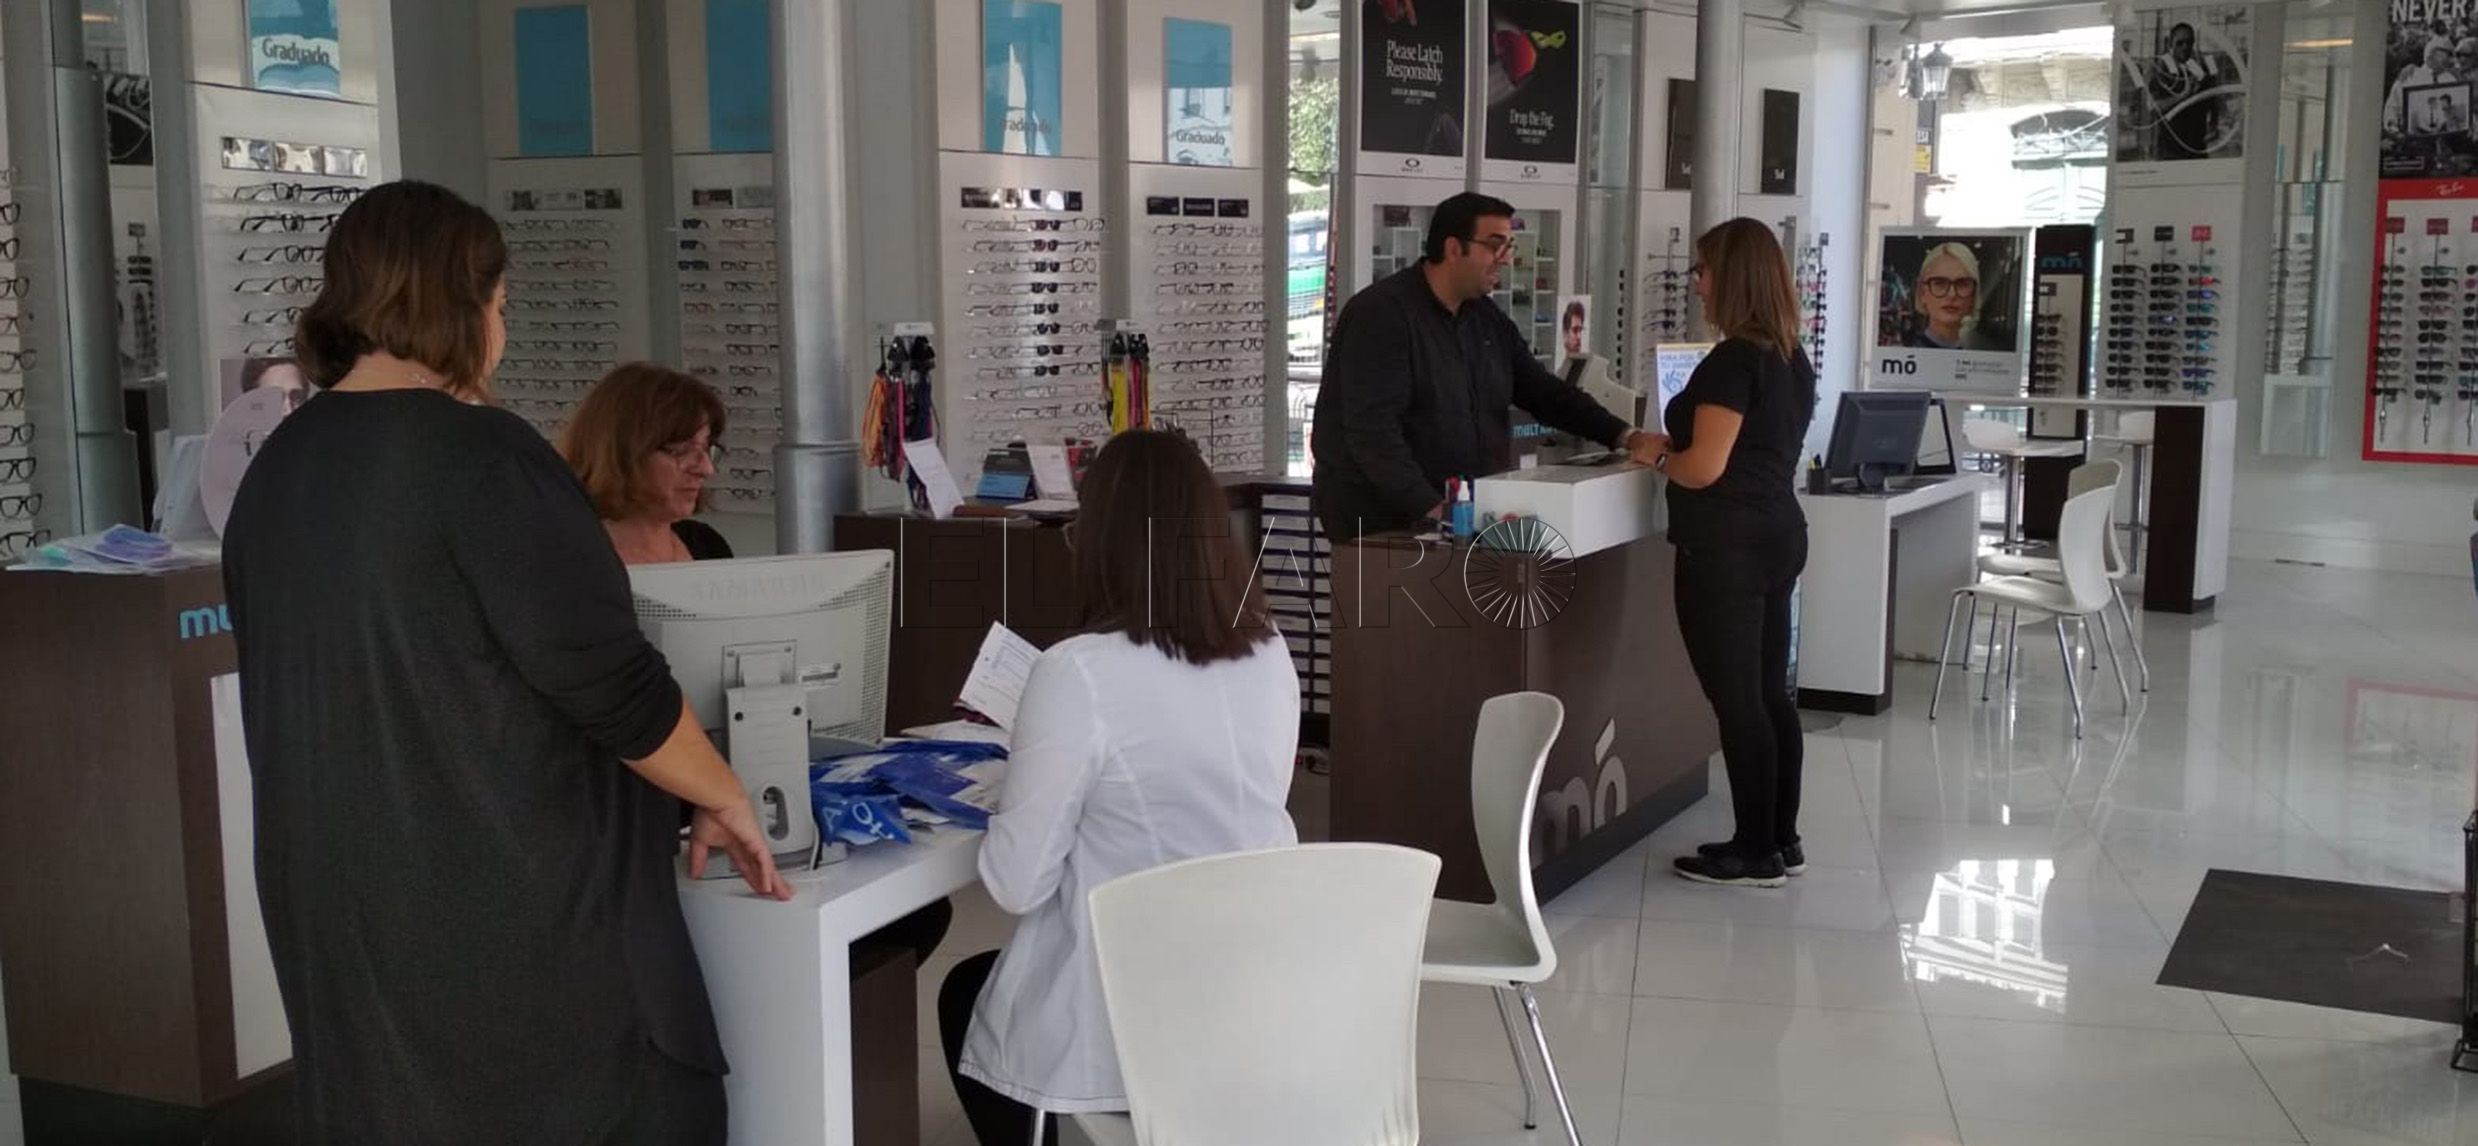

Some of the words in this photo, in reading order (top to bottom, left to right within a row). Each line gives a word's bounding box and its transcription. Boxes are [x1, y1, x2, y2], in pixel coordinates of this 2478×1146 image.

[2391, 0, 2467, 24] NEVER
[262, 37, 330, 66] Graduado
[1386, 40, 1416, 61] Please
[1417, 44, 1443, 64] Latch
[1176, 129, 1226, 145] Graduado
[1881, 354, 1917, 375] mó
